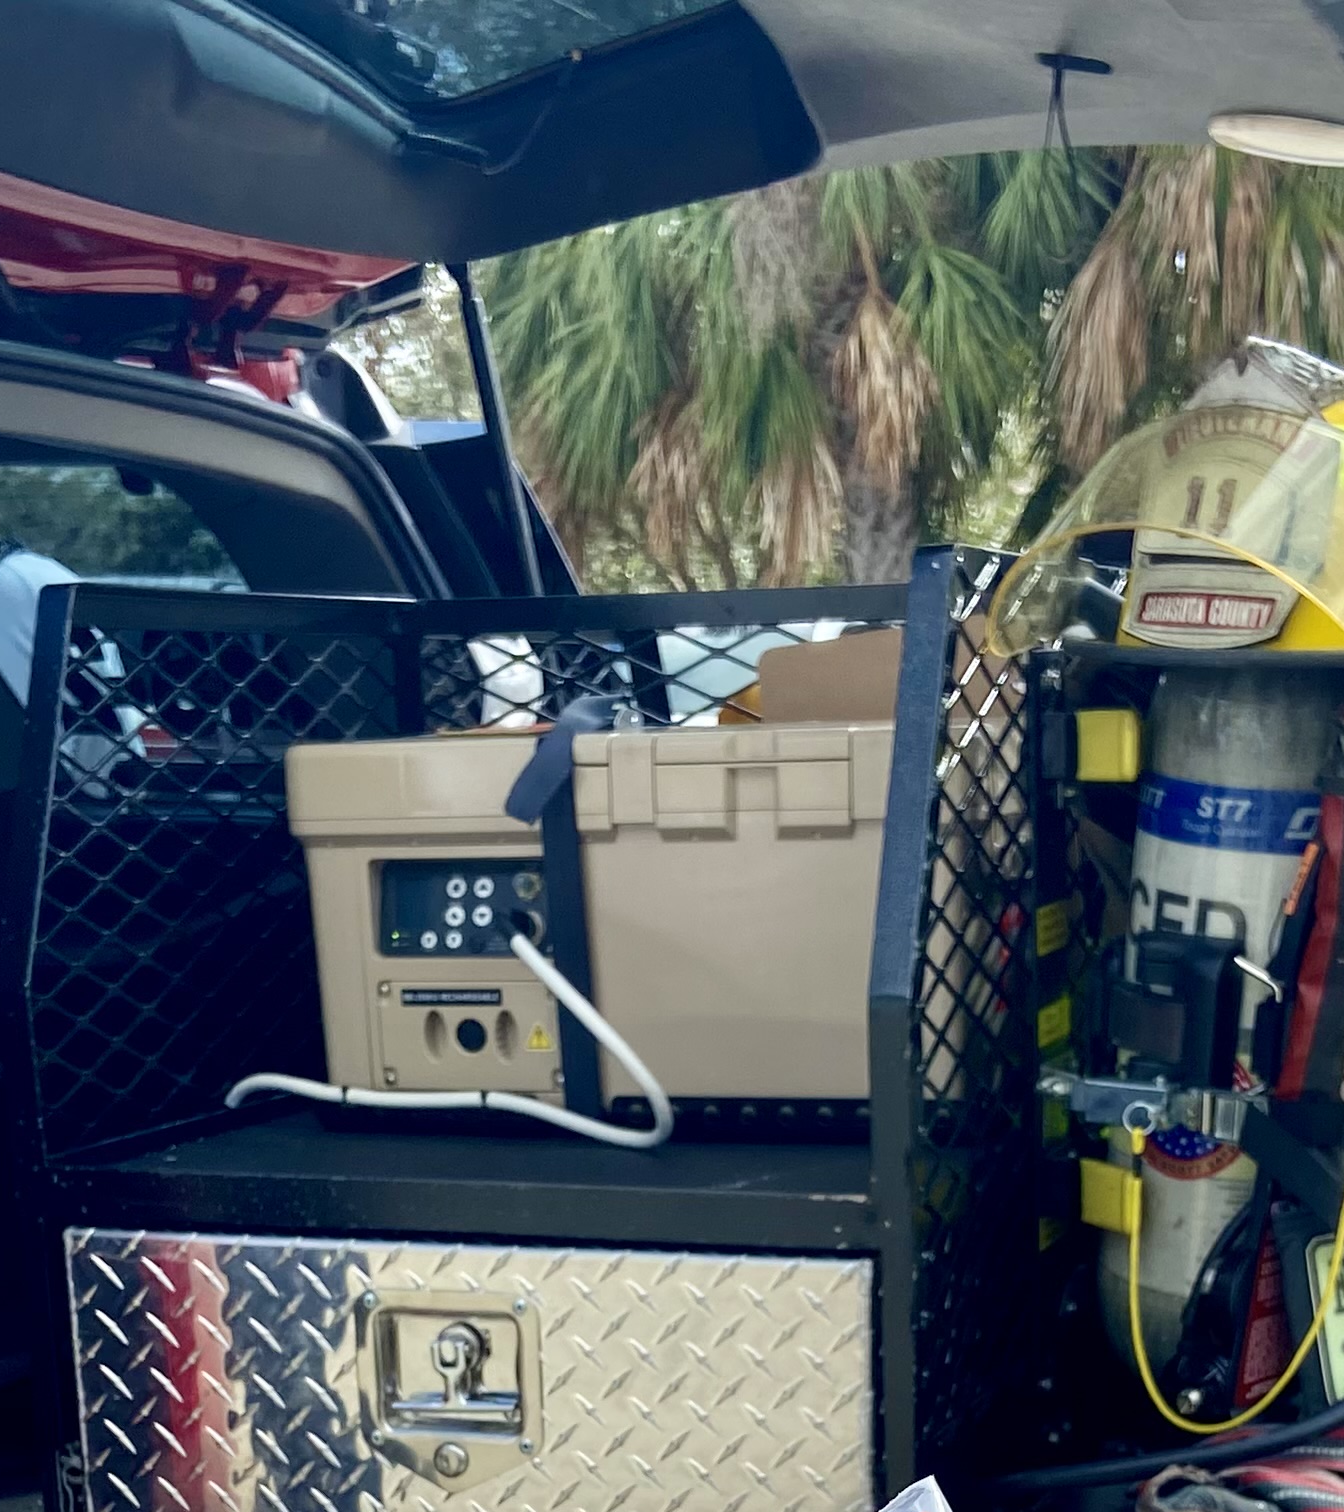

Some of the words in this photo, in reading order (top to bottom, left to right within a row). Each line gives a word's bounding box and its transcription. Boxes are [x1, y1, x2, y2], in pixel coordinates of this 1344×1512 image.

[1185, 476, 1237, 537] 11
[1208, 599, 1271, 628] COUNTY
[1197, 796, 1252, 822] ST7
